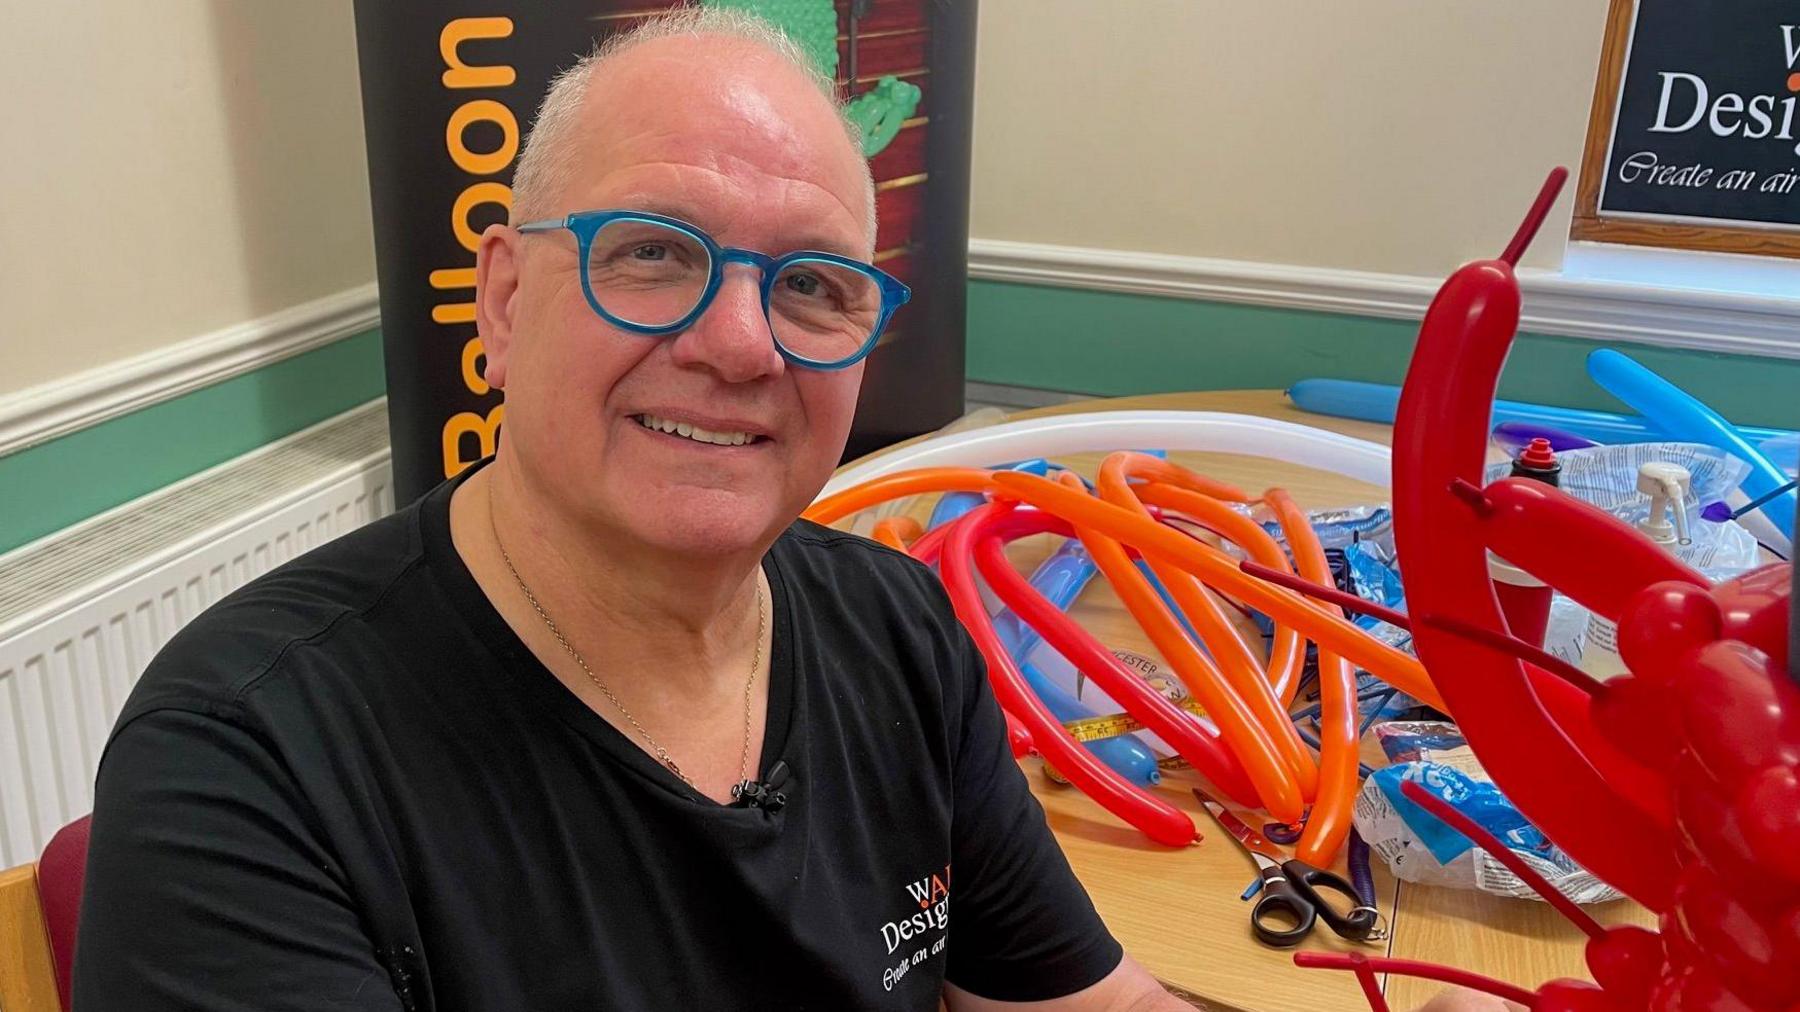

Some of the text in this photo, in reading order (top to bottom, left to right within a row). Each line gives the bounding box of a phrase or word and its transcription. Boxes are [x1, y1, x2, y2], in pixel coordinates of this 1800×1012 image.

[1647, 71, 1800, 157] Desi
[1619, 151, 1713, 187] Create
[1716, 169, 1755, 190] an
[1112, 651, 1157, 674] CESTER
[912, 948, 928, 966] an
